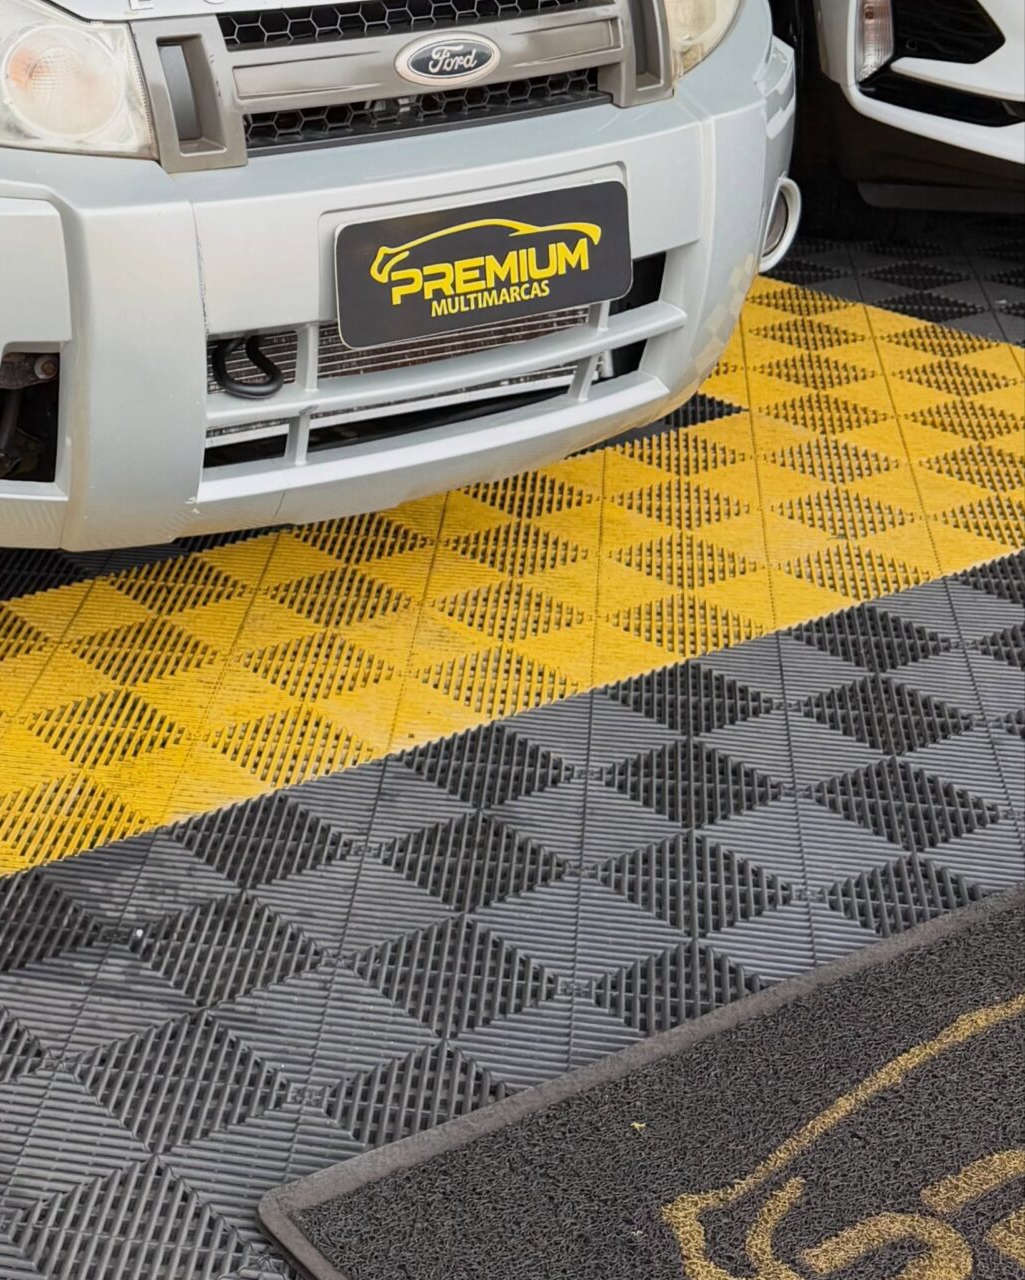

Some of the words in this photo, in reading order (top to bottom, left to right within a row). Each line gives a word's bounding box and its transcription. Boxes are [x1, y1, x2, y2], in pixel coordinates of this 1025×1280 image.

[428, 44, 478, 73] Ford
[390, 237, 590, 306] PREMIUM
[430, 279, 551, 318] MULTIMARCAS
